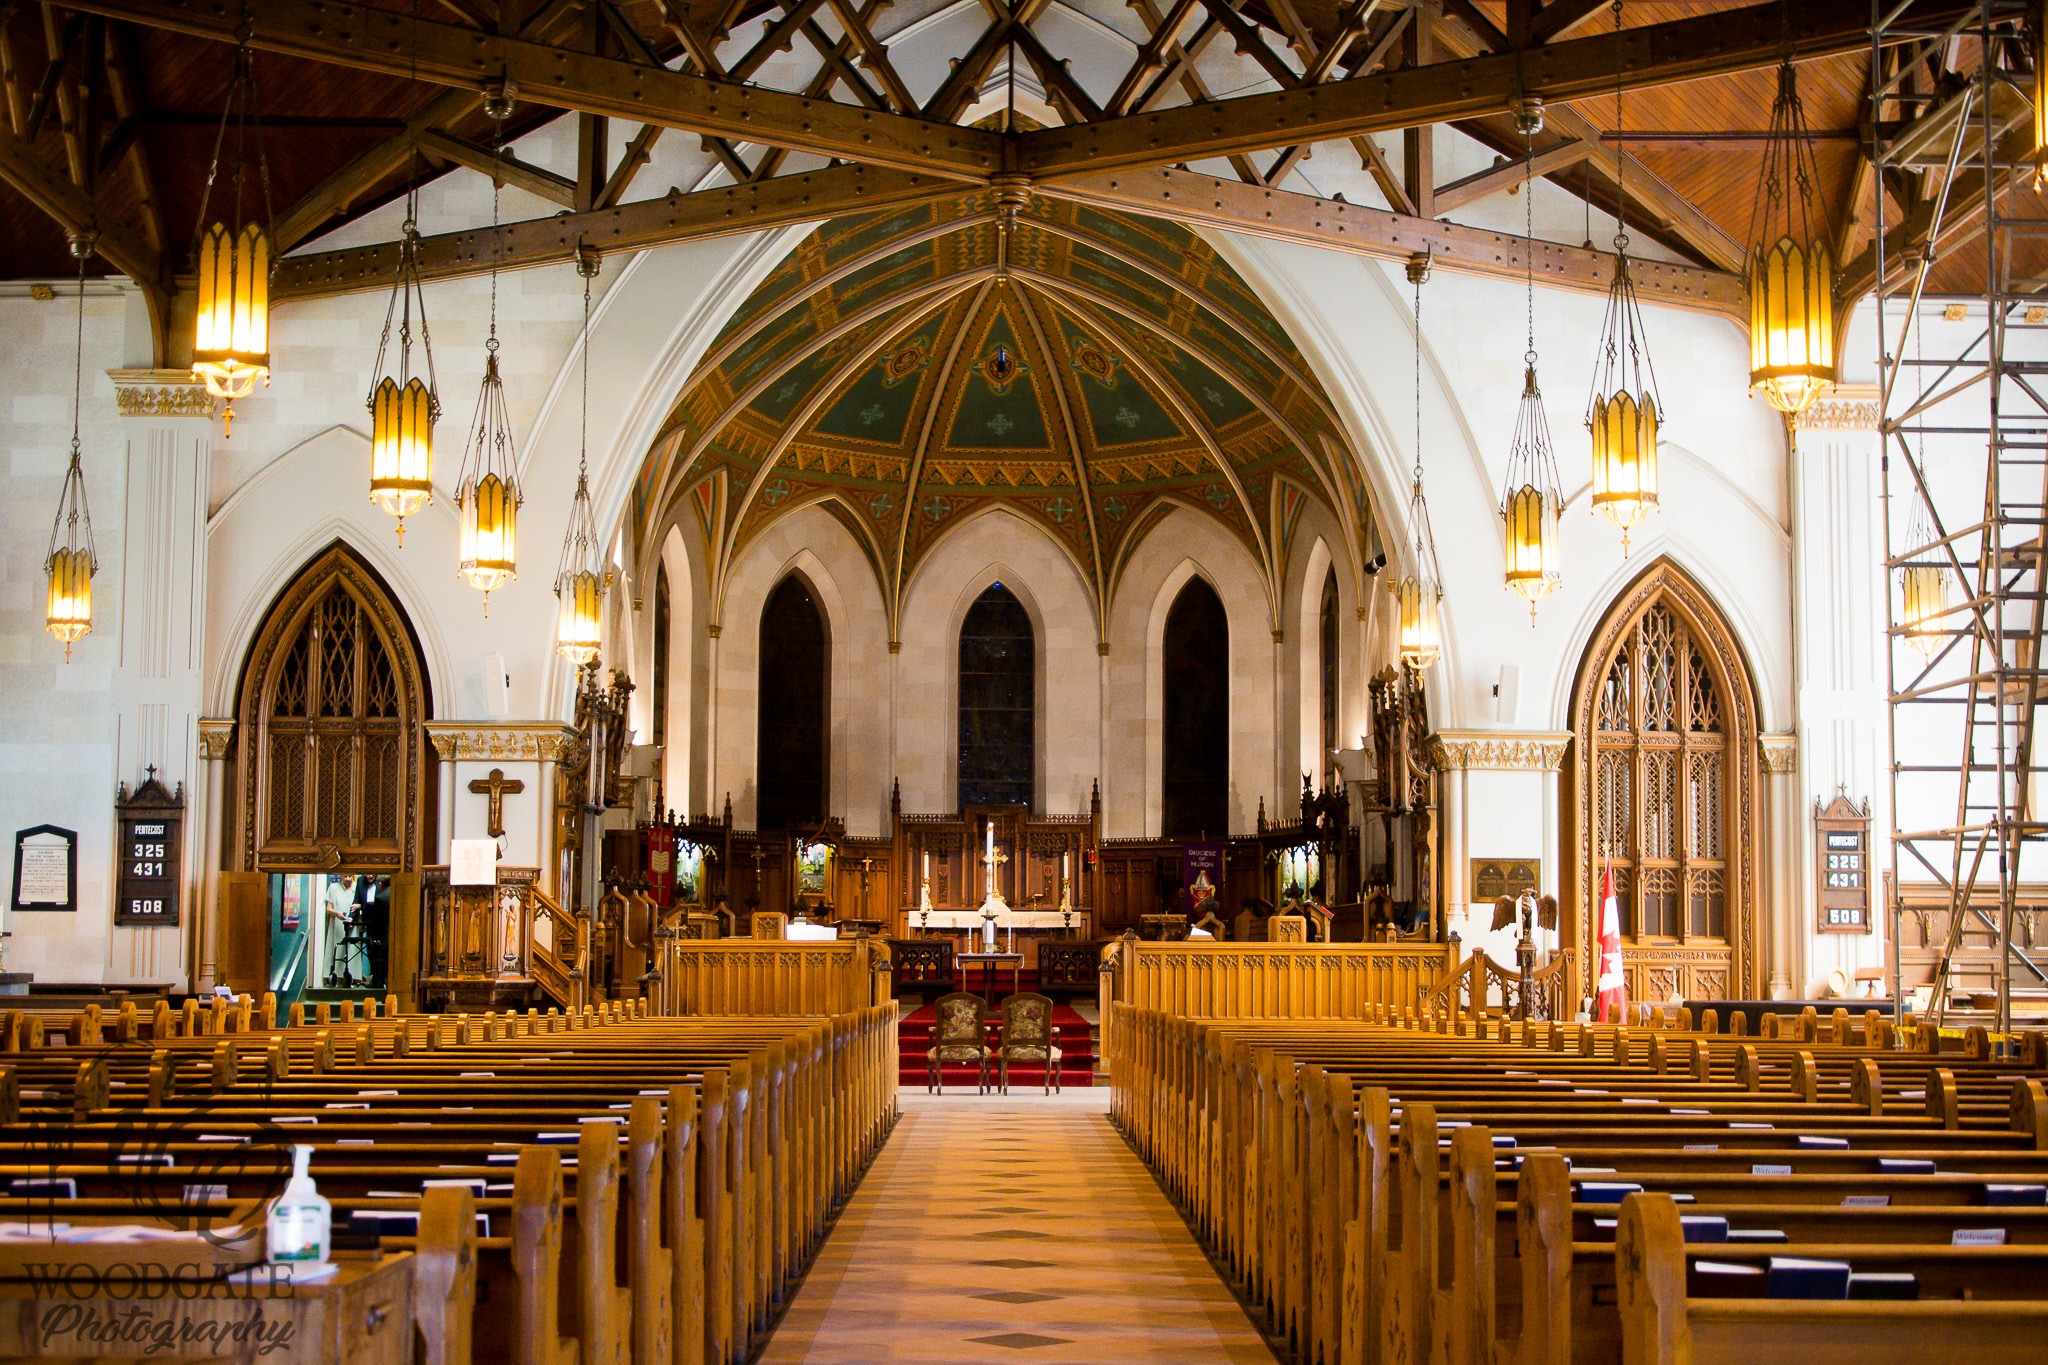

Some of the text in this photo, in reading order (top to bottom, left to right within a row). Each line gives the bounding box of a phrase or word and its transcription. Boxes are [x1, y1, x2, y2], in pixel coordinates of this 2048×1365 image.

[134, 824, 165, 835] PENTECOST
[134, 844, 164, 858] 325
[1188, 849, 1217, 857] DIOCESE
[133, 862, 164, 876] 431
[1829, 855, 1859, 869] 325
[1829, 873, 1859, 887] 431
[132, 900, 163, 914] 508
[1829, 909, 1860, 924] 508
